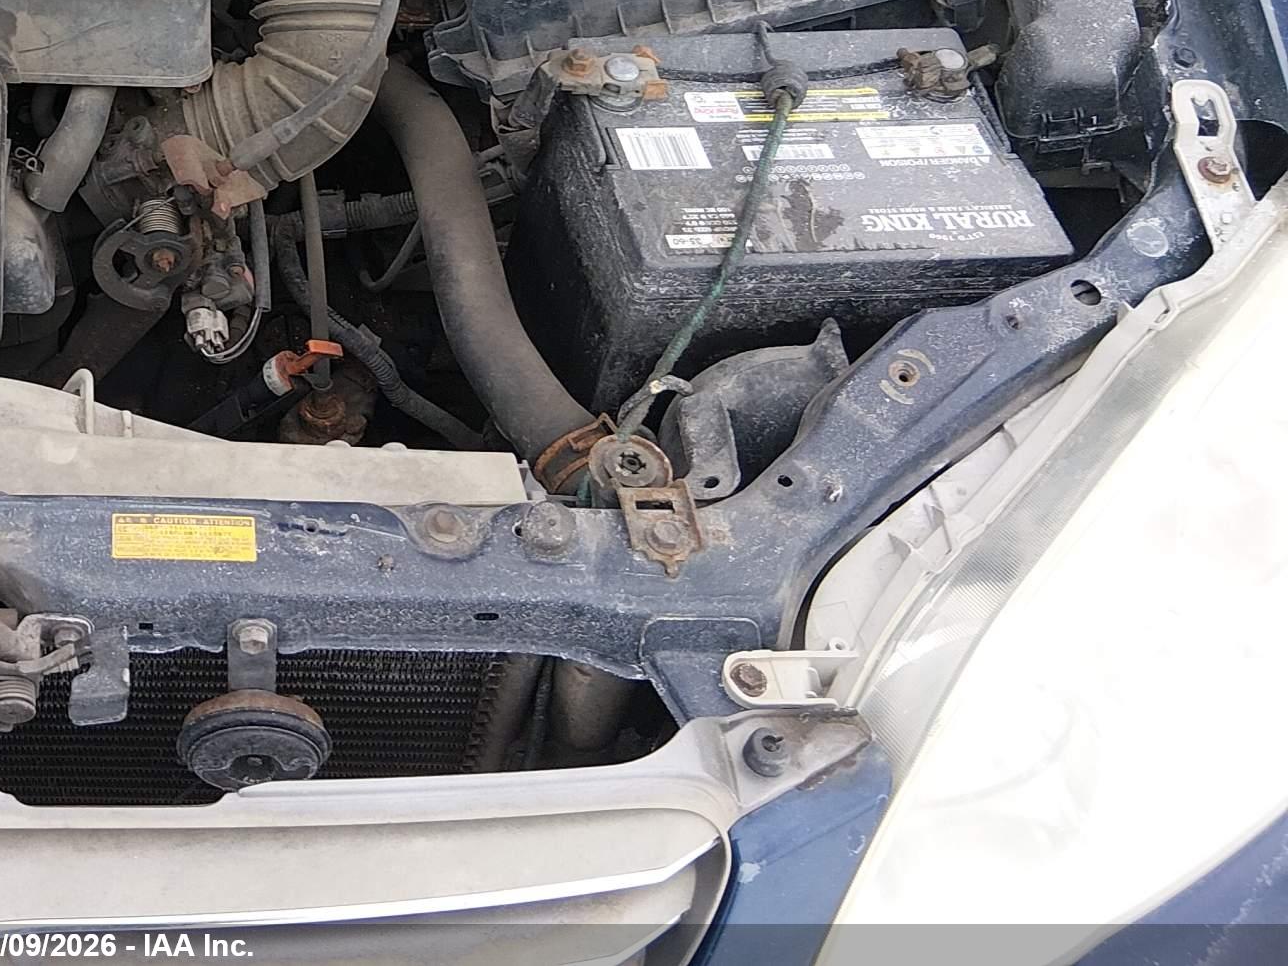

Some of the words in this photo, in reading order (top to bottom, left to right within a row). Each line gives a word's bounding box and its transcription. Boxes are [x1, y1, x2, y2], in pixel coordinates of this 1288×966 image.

[861, 213, 934, 232] KING
[932, 210, 1035, 230] RURAL
[153, 516, 197, 525] CAUTION
[202, 518, 251, 527] ATTENTION
